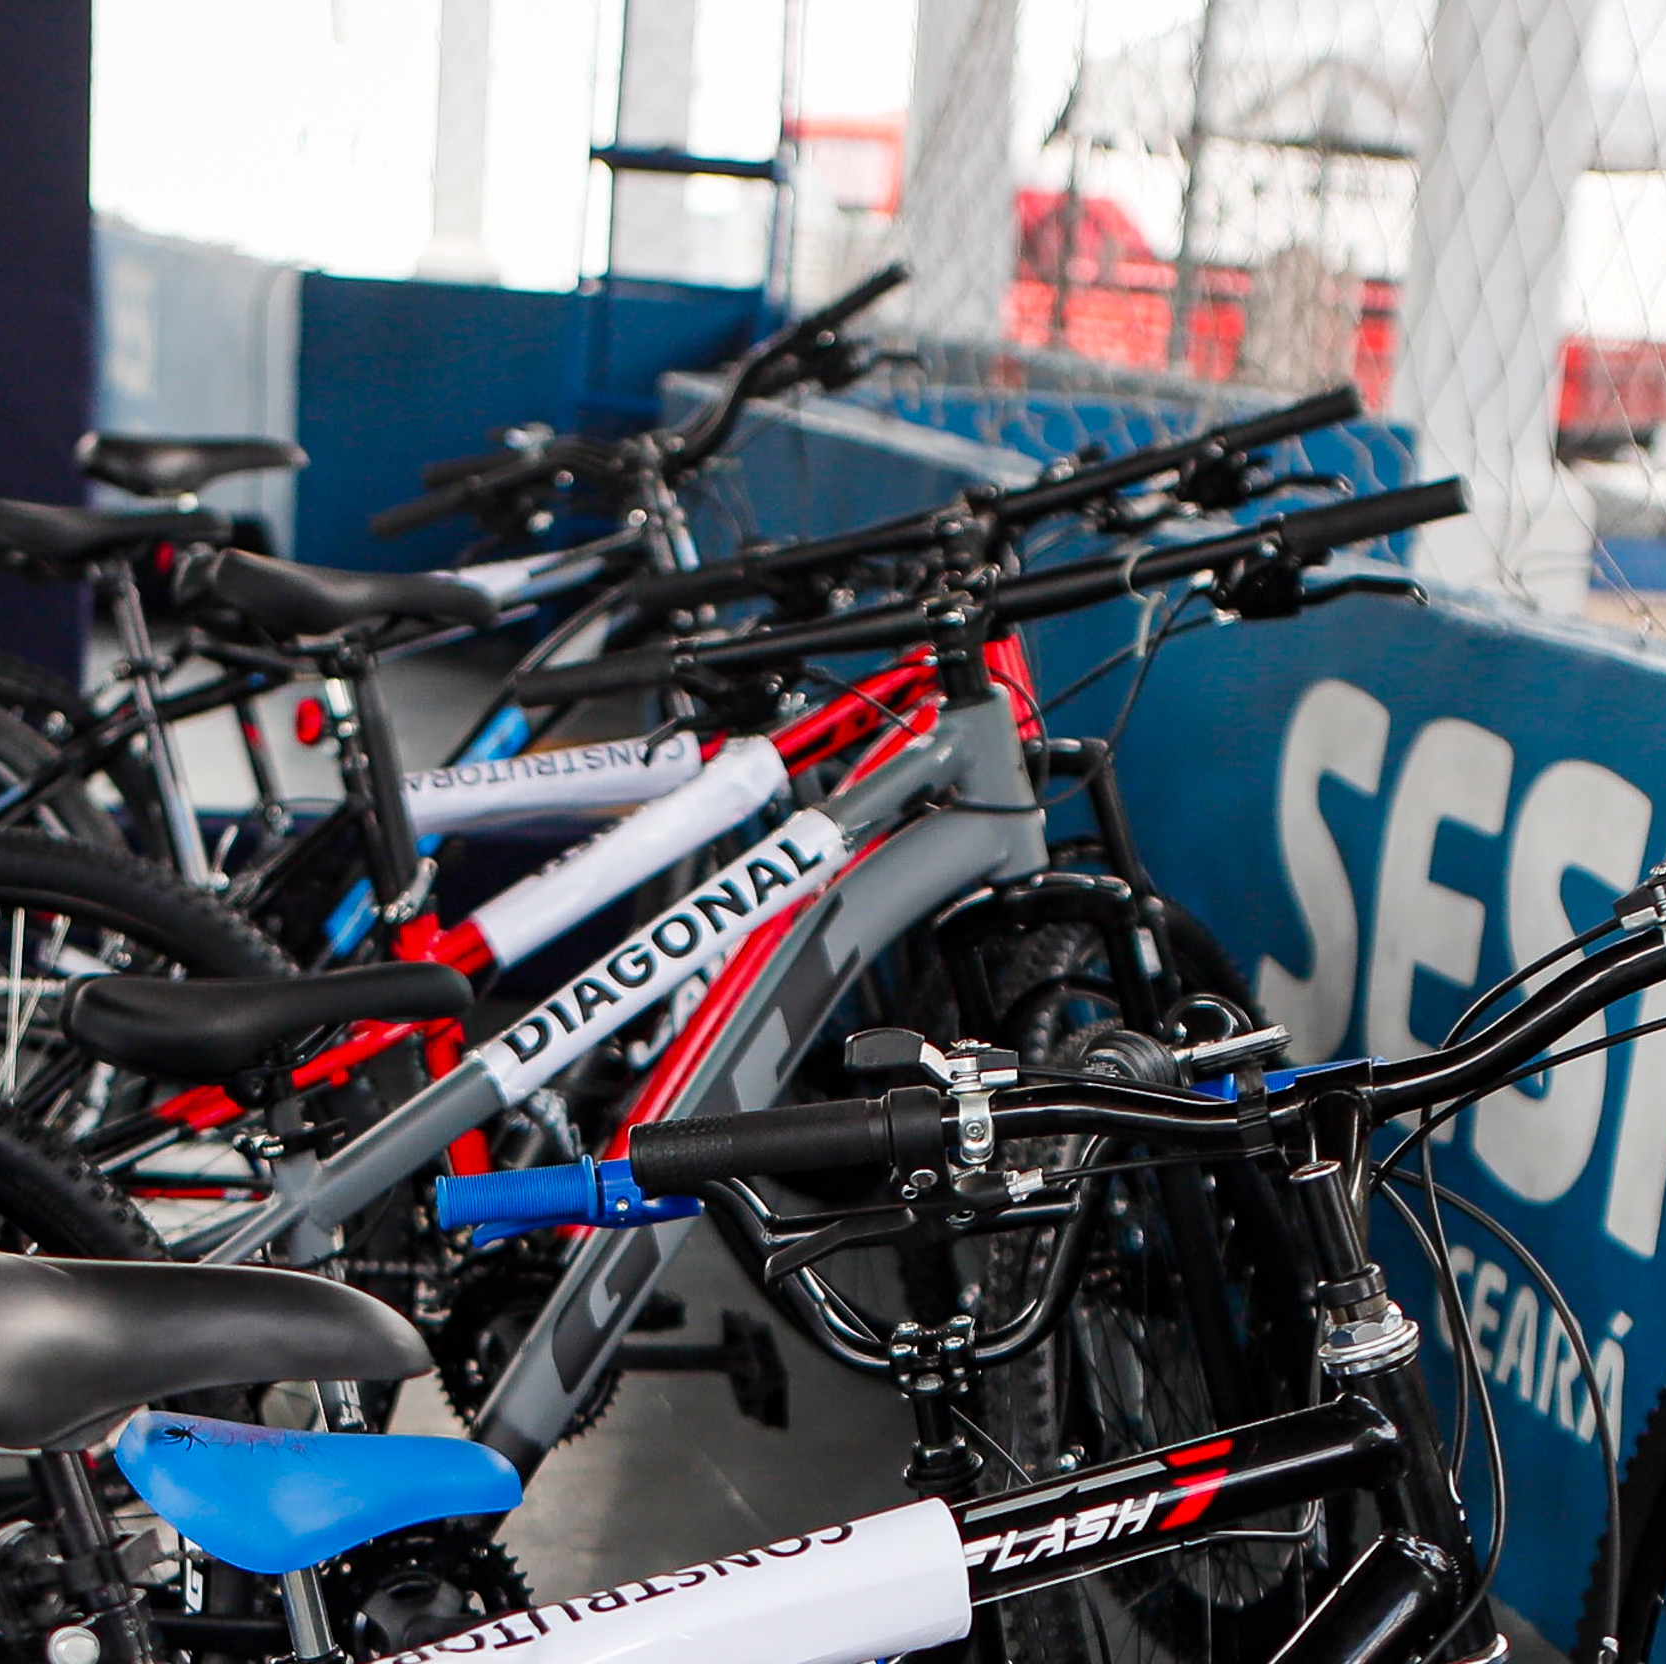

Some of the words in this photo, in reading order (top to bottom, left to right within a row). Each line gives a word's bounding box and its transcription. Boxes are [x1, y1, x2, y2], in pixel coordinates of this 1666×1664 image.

[503, 832, 824, 1065] DIAGONAL
[1434, 1243, 1633, 1461] CEARÁ
[964, 1491, 1160, 1573] FLASH
